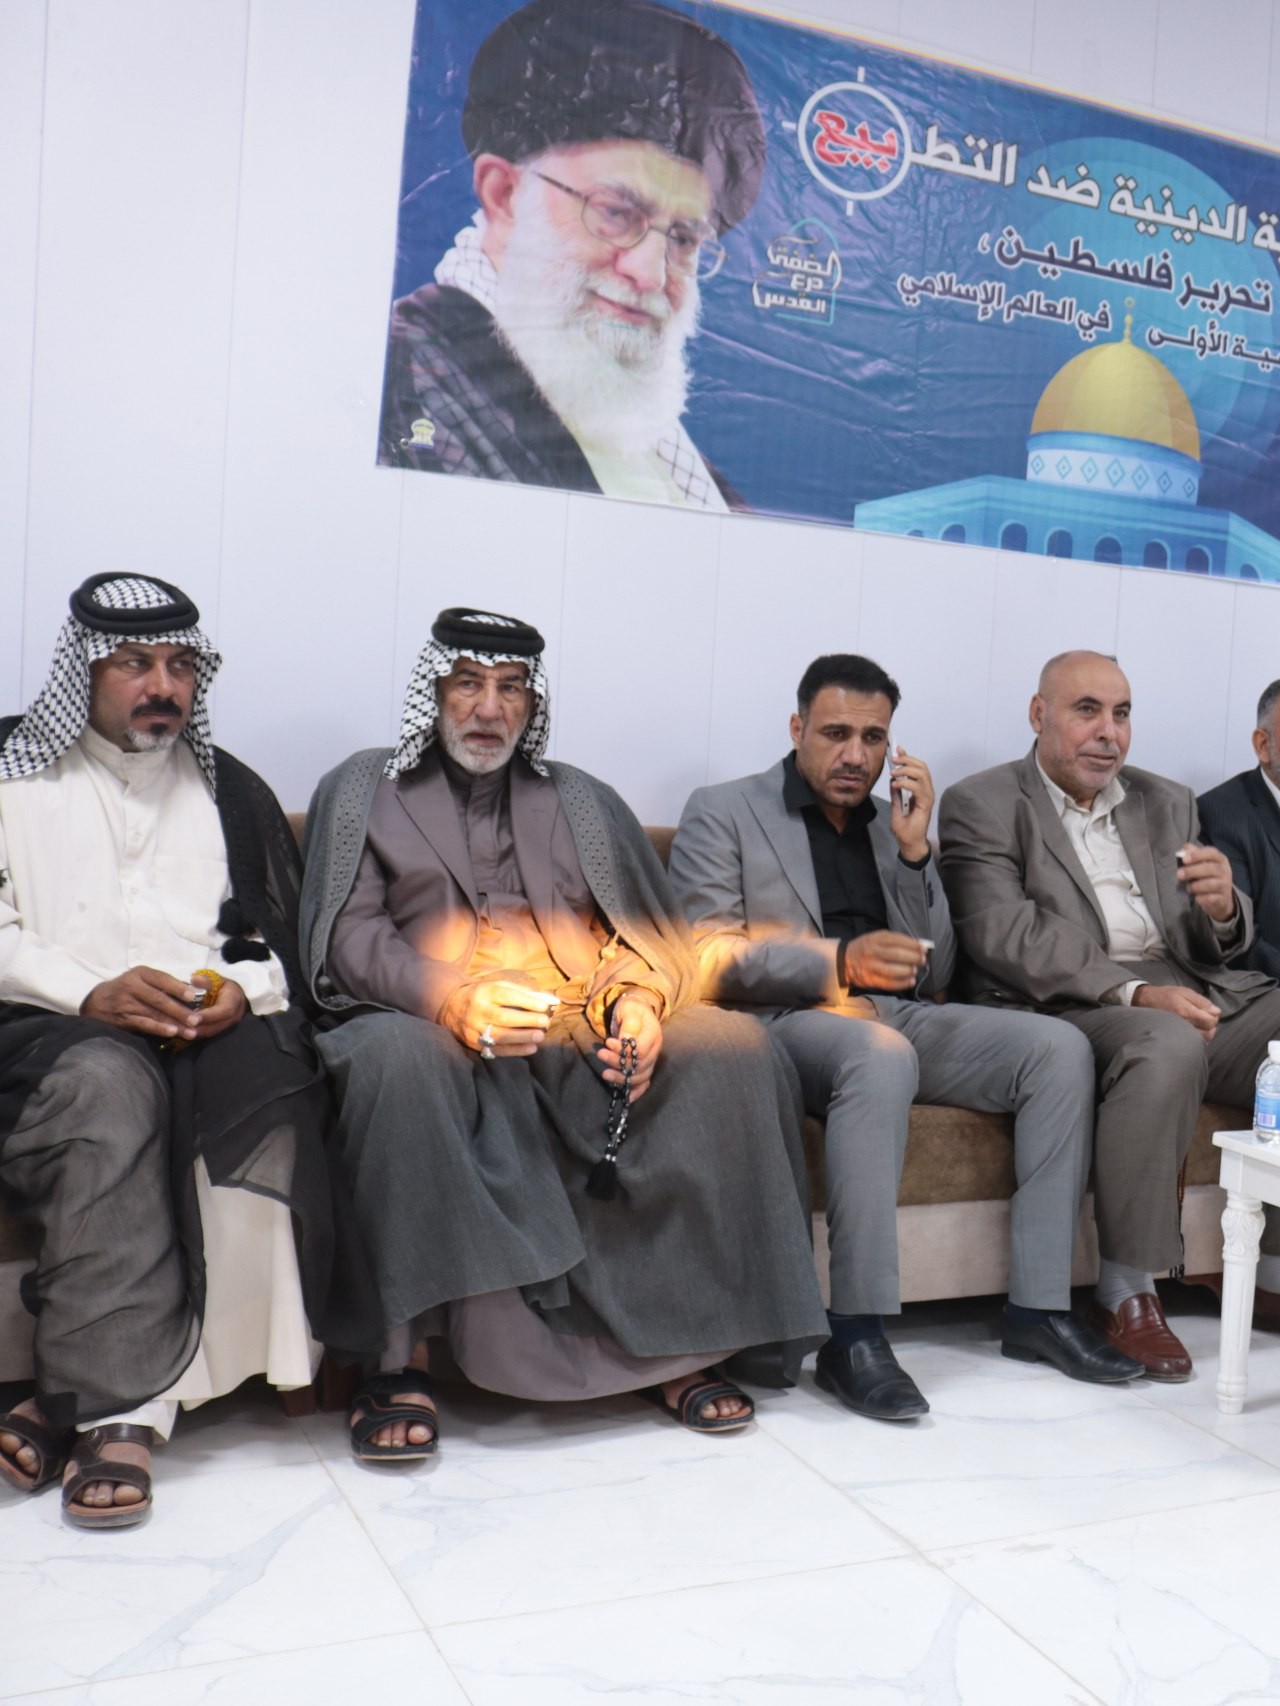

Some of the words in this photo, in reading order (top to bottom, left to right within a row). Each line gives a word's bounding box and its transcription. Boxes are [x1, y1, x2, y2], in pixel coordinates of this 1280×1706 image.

[1026, 163, 1100, 209] ضد
[1108, 174, 1249, 245] الدينية
[994, 225, 1176, 291] فلسطين
[752, 275, 827, 313] القدس
[897, 271, 1006, 322] الإسلامي
[1004, 291, 1076, 323] العالم
[1176, 273, 1273, 315] تحرير
[1076, 301, 1112, 342] في
[1147, 319, 1229, 360] الأولى
